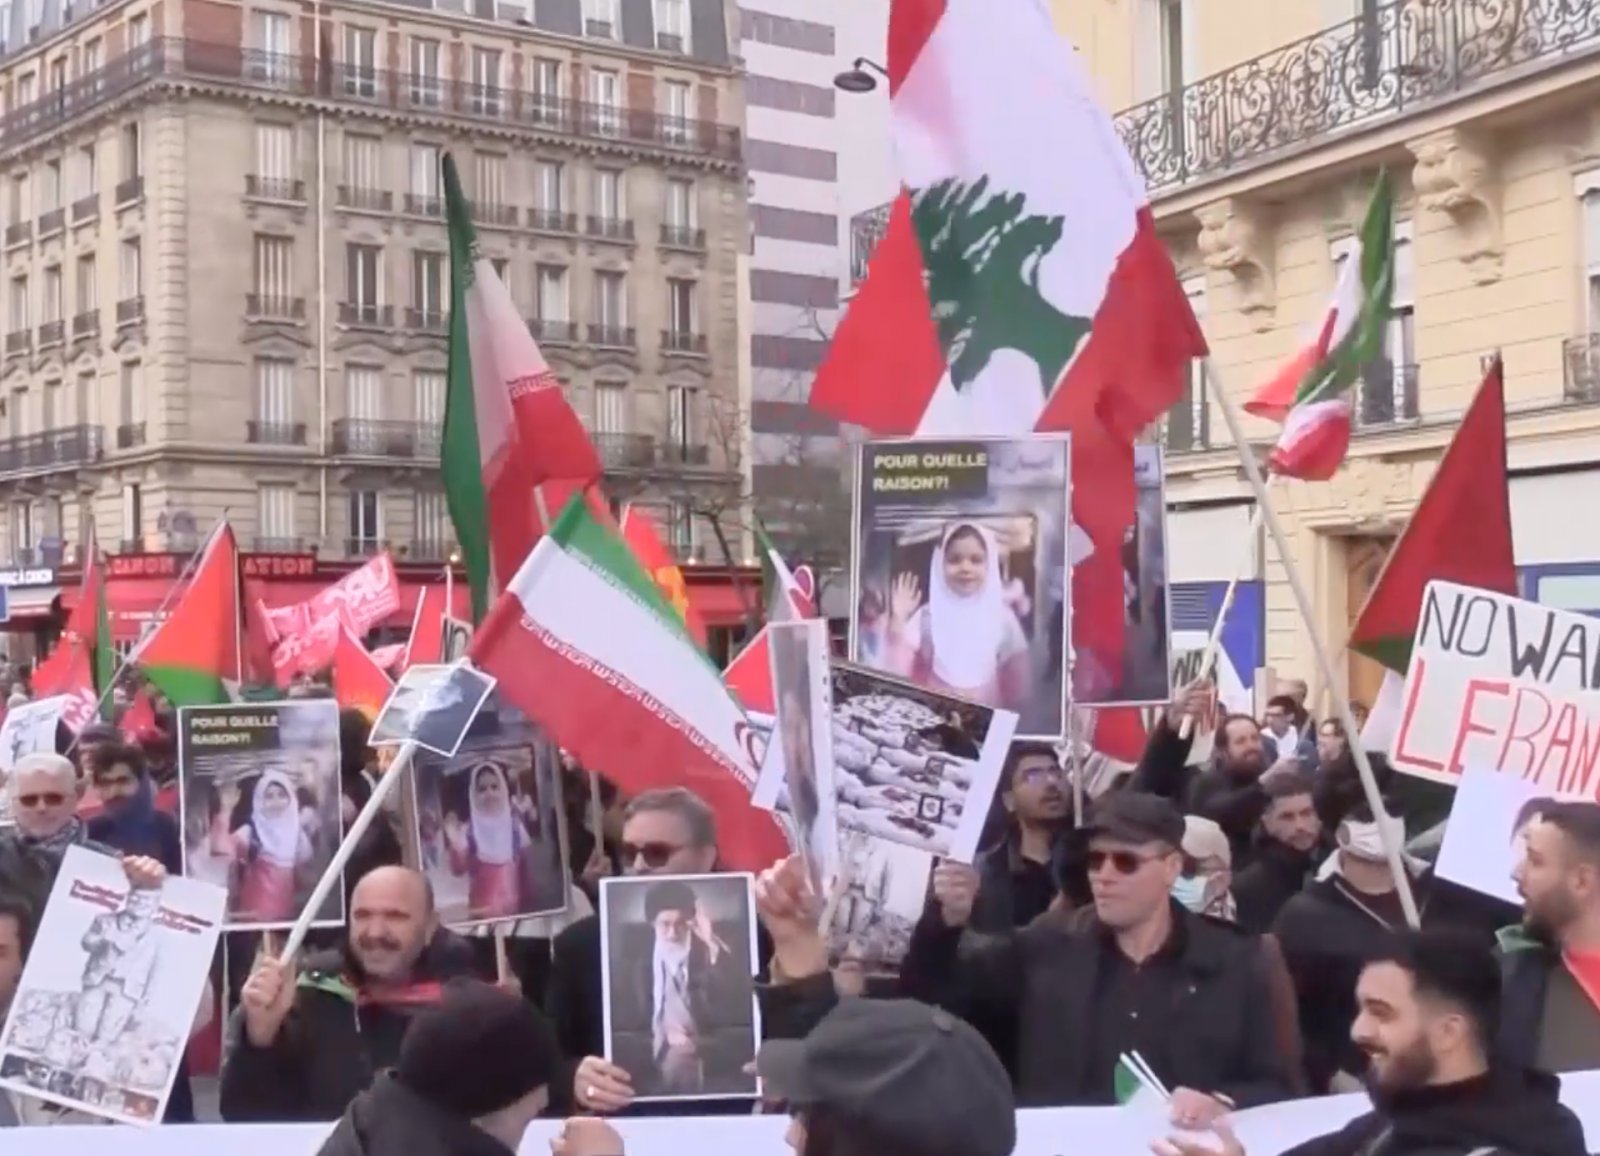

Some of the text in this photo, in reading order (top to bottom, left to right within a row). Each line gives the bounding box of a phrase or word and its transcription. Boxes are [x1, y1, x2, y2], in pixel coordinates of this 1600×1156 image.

[873, 455, 918, 469] POUR
[922, 452, 987, 468] QUELLE
[873, 476, 949, 491] RAISON?!
[244, 557, 314, 575] ATION
[1420, 586, 1498, 657] NO
[191, 717, 227, 730] POUR
